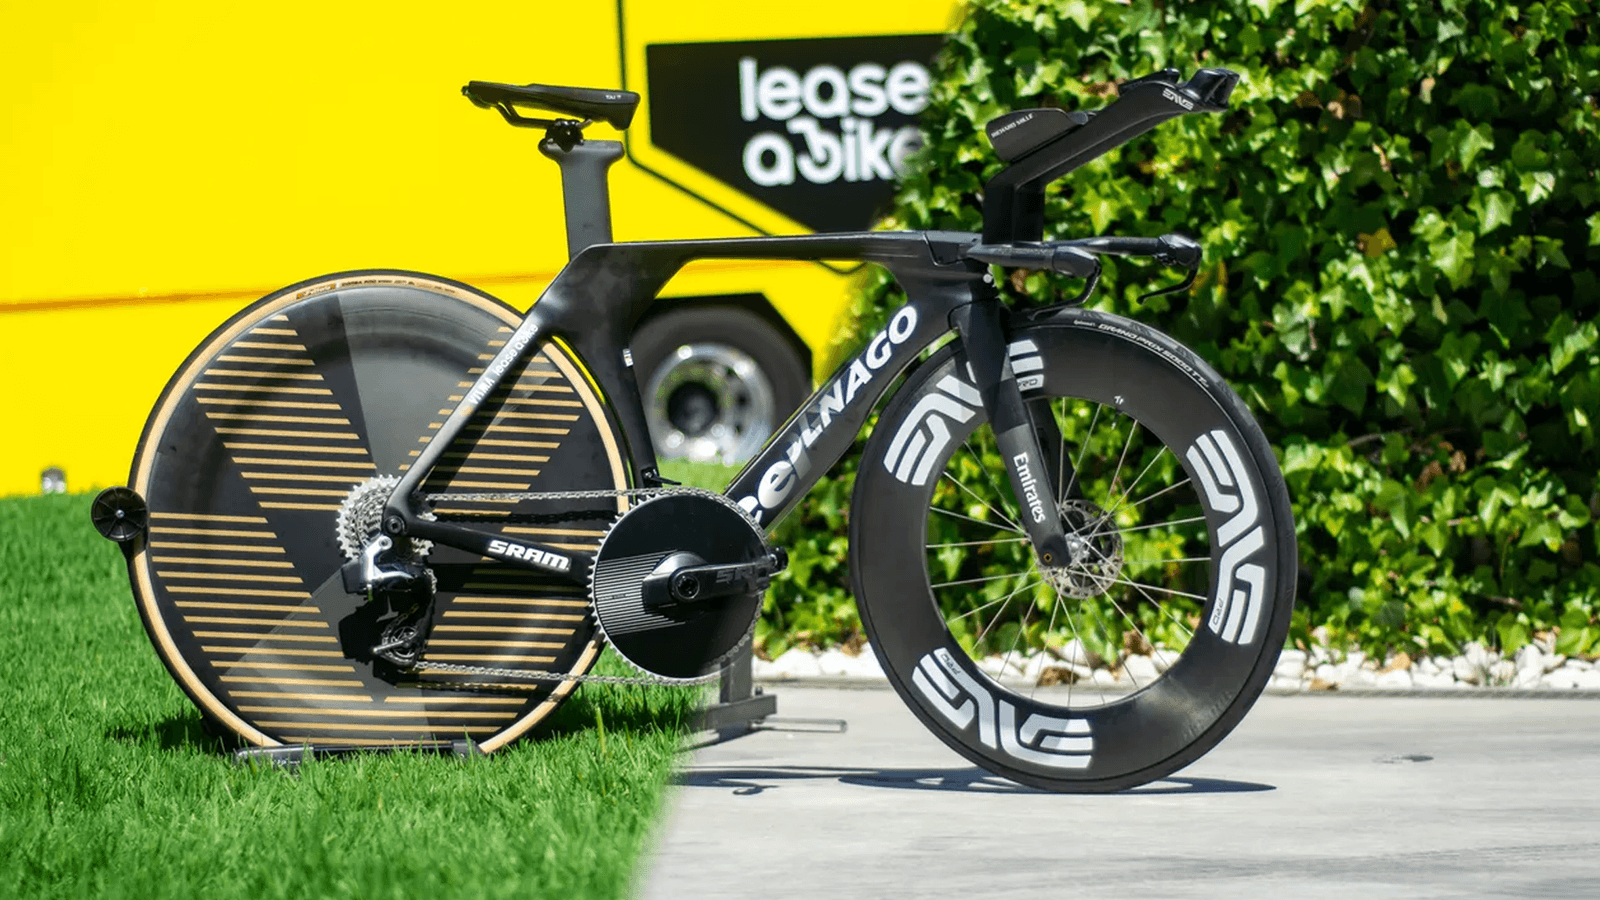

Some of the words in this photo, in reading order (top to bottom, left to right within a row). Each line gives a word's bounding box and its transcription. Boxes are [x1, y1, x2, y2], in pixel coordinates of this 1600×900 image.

[739, 57, 930, 121] lease
[1098, 323, 1137, 340] GRAND
[1136, 336, 1164, 352] PRIX
[1162, 350, 1193, 373] 5000
[1013, 451, 1046, 524] Emirates
[487, 539, 570, 572] SRAM
